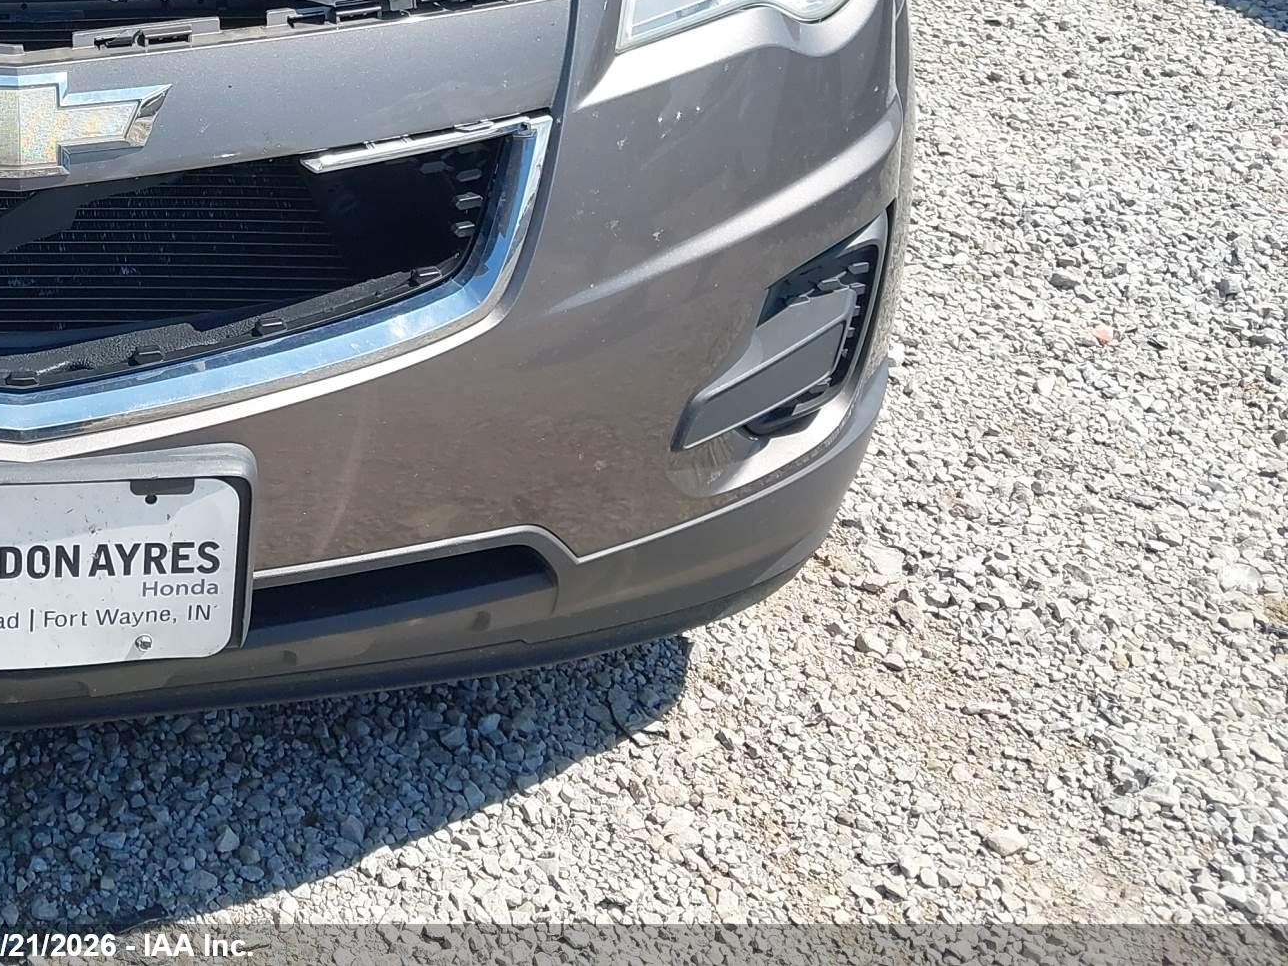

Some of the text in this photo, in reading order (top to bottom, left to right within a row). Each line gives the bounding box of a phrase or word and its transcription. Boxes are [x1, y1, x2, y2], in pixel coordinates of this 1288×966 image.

[89, 541, 220, 577] AYRES
[142, 580, 219, 597] Honda
[44, 610, 88, 628] Fort
[95, 608, 178, 628] Wayne,
[187, 604, 211, 622] IN
